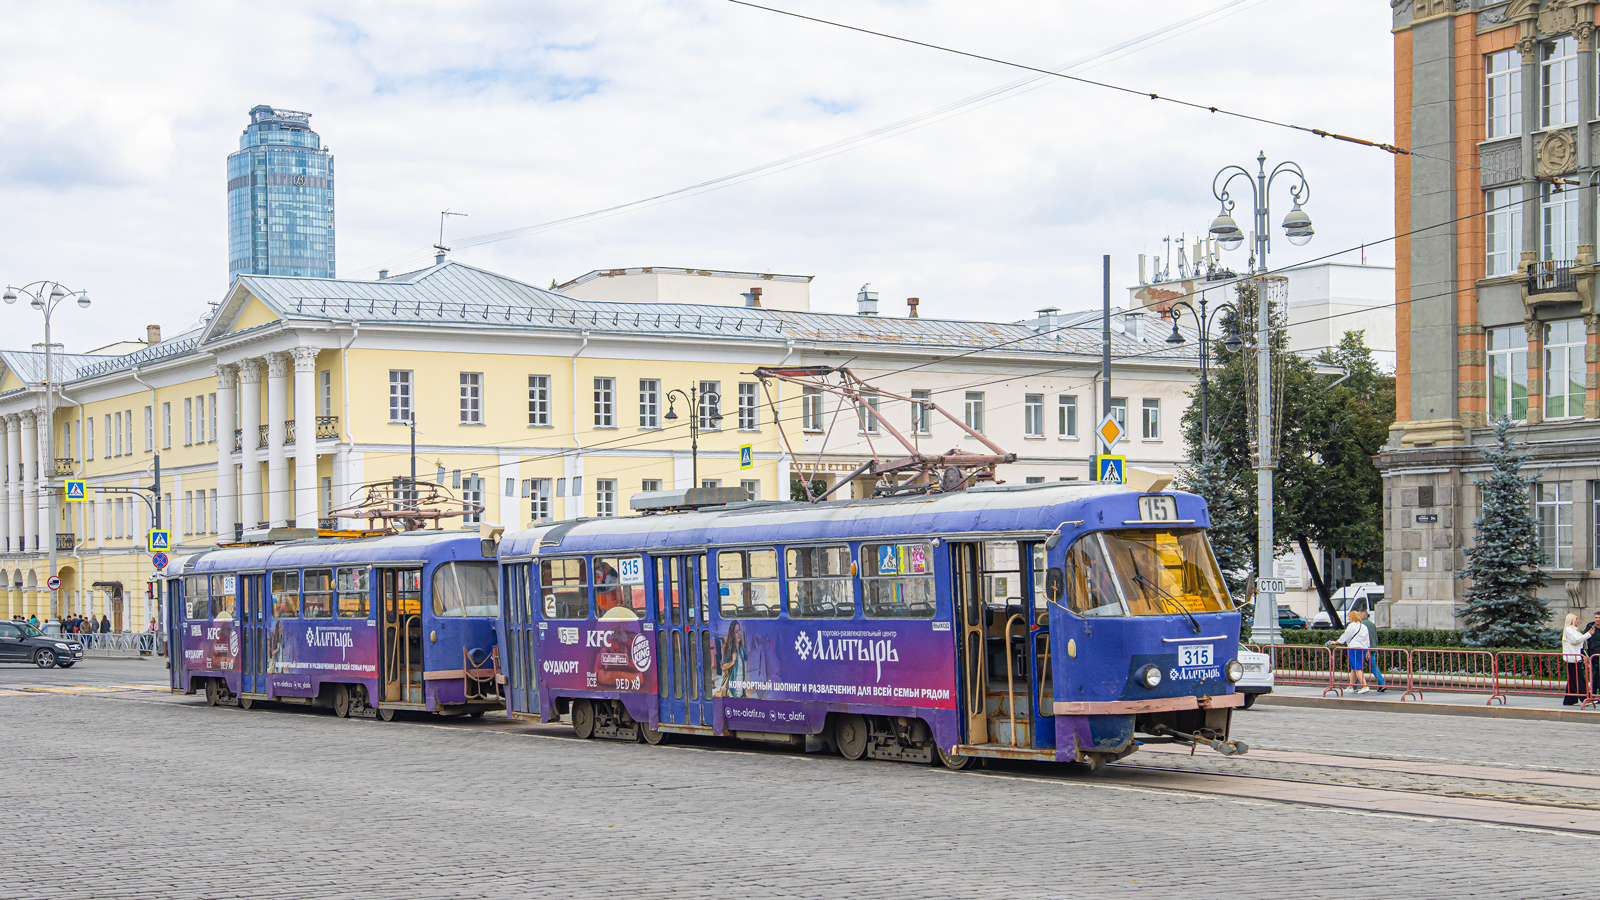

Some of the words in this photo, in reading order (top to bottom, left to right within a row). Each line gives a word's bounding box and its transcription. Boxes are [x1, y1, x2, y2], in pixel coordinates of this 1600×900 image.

[1145, 498, 1168, 520] 15
[622, 560, 639, 575] 315
[1261, 580, 1283, 590] СТОП
[207, 628, 221, 640] KFC
[586, 630, 614, 648] KFC
[634, 647, 650, 664] KING
[1184, 650, 1208, 664] 315
[544, 660, 578, 674] ФУДКОРТ
[586, 678, 598, 687] ICE
[616, 678, 630, 690] DED
[728, 680, 772, 690] КОМФОРТНЫЙ
[774, 683, 801, 692] ШОПИНГ
[802, 684, 807, 692] И
[808, 684, 856, 694] РАЗВЛЕЧЕНИЯ
[857, 686, 872, 696] ДЛЯ
[873, 684, 892, 696] ВСЕЙ
[894, 688, 920, 698] СЕМЬИ
[922, 690, 950, 700] РЯДОМ
[733, 708, 765, 718] trc-alatir.ru
[778, 712, 805, 721] trc_alatir
